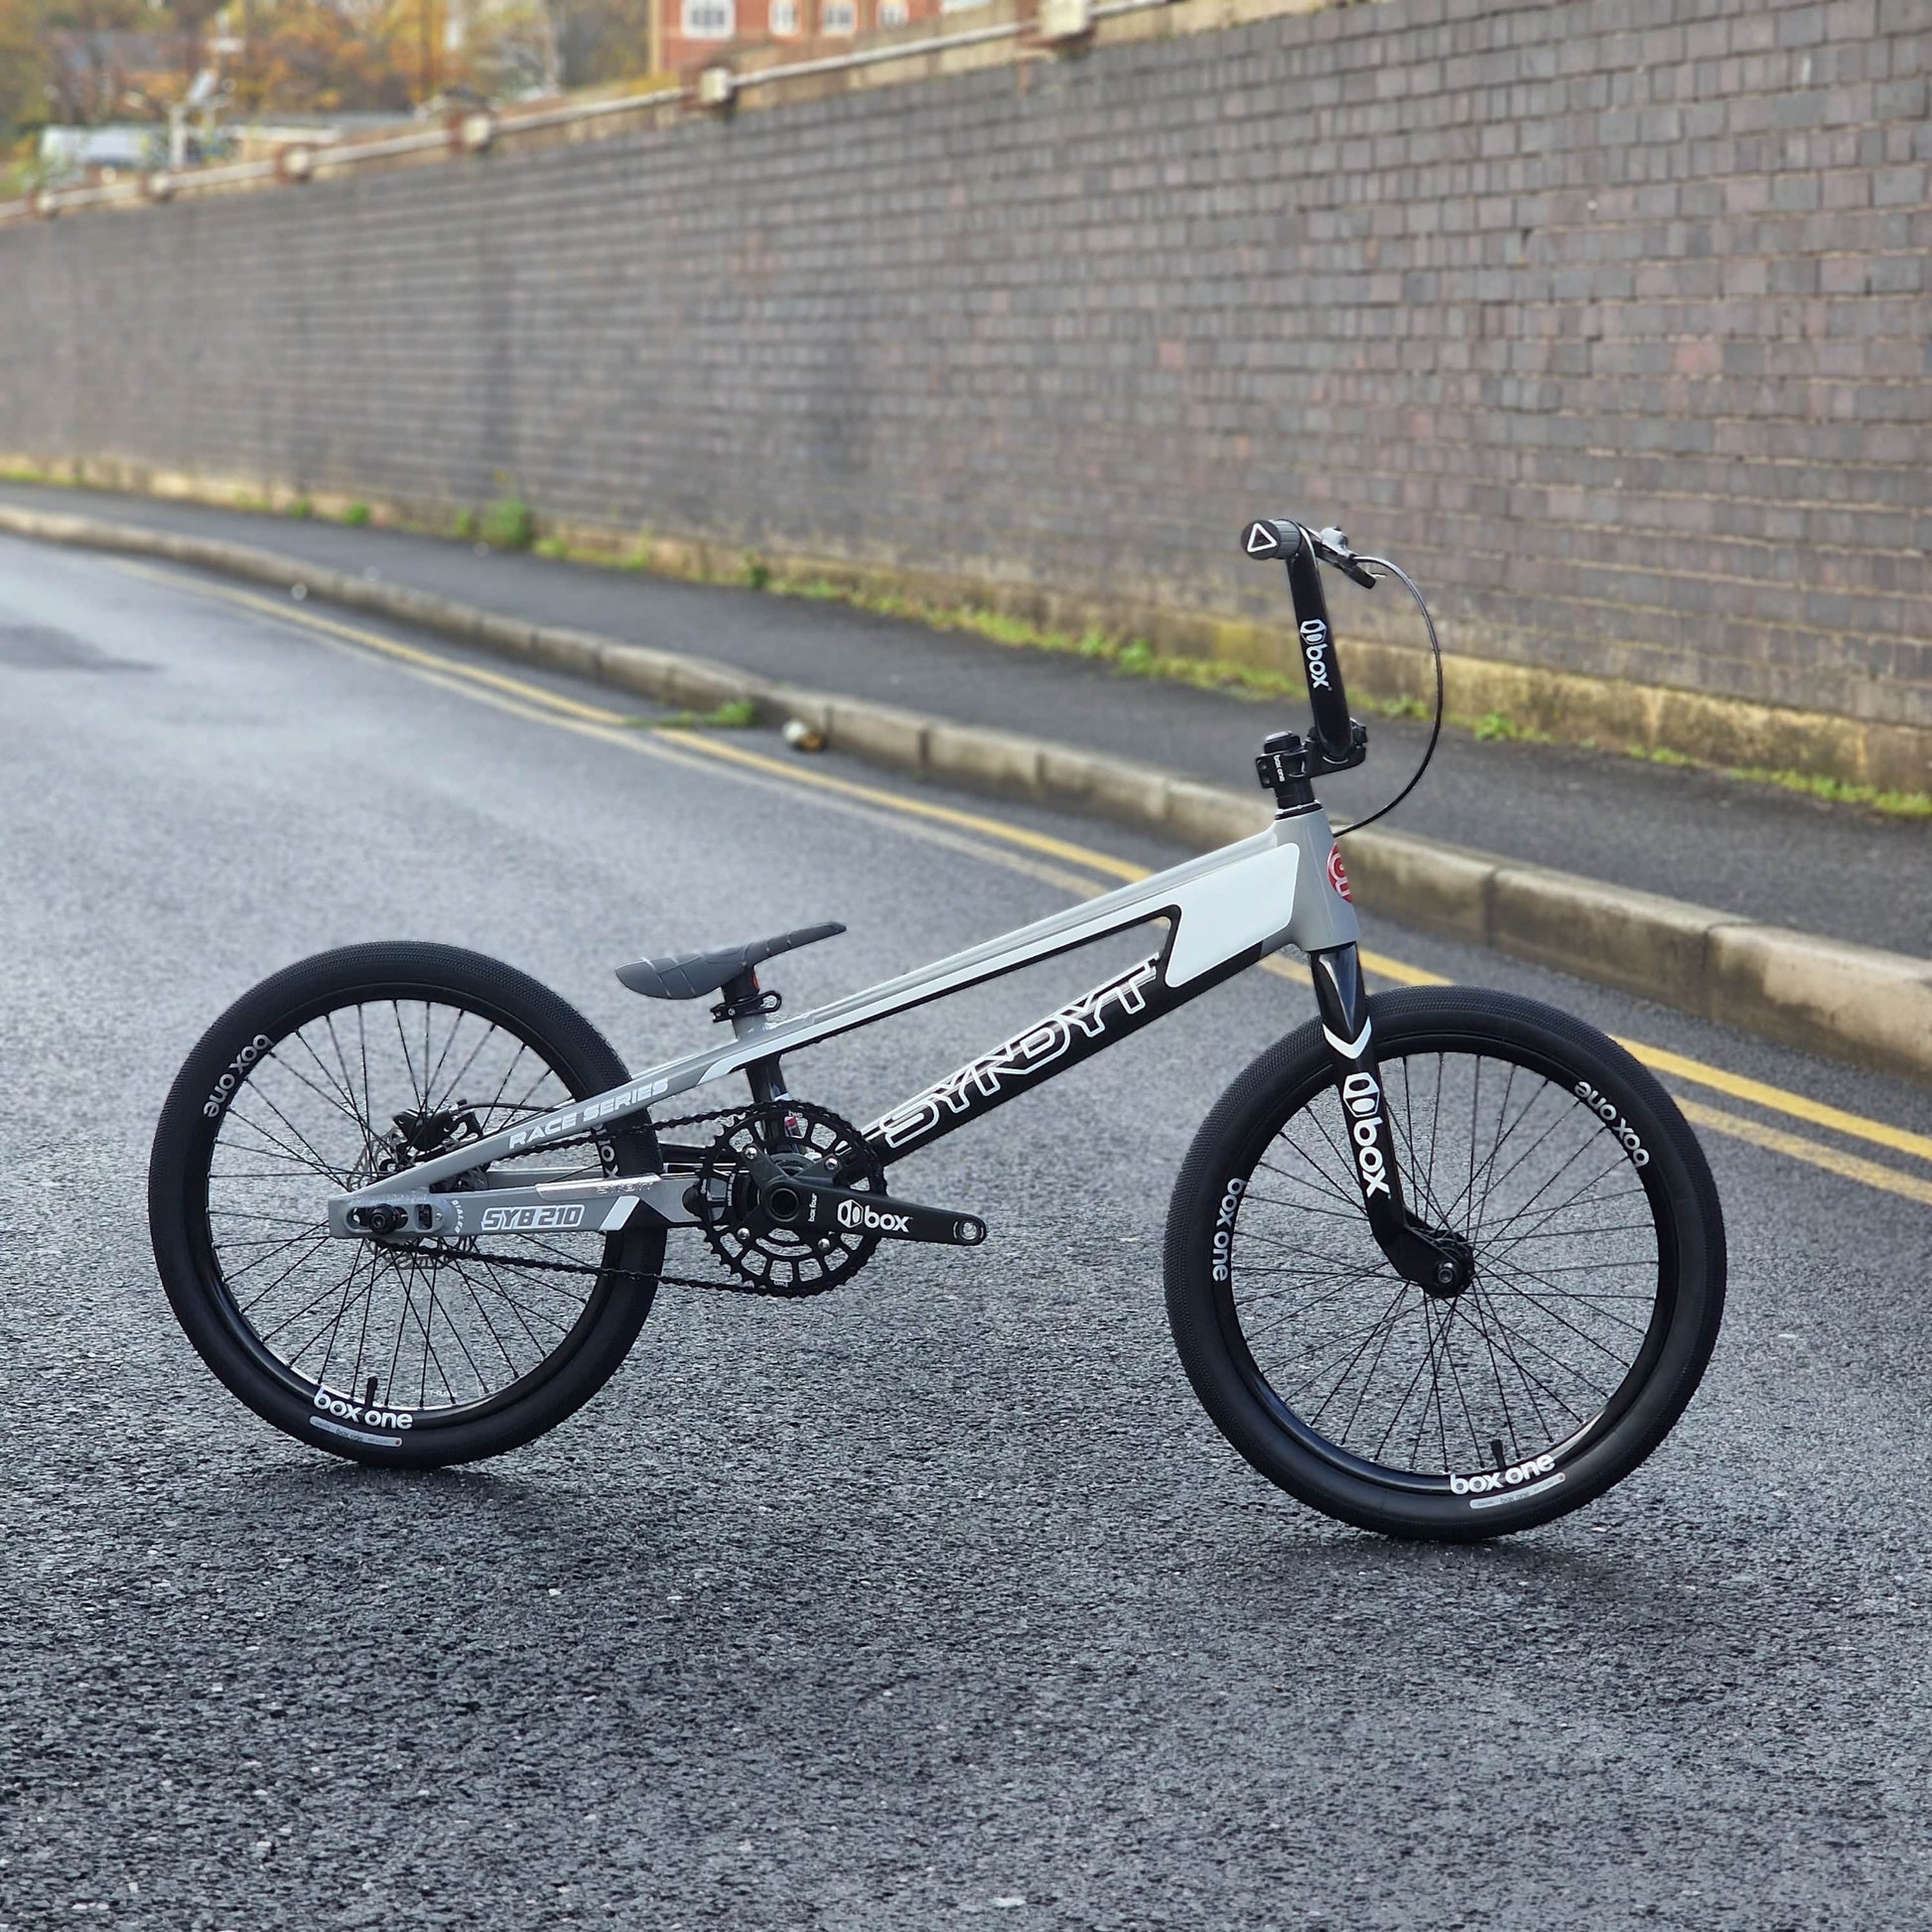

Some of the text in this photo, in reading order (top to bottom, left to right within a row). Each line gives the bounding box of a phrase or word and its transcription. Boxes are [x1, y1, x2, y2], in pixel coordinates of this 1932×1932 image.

[1307, 643, 1329, 688] box
[203, 1034, 276, 1118] box one
[508, 1077, 668, 1150] RACE SERIES
[1574, 1081, 1650, 1169] box one
[1353, 1116, 1391, 1199] box
[481, 1204, 585, 1231] SYB 210
[807, 1208, 816, 1222] box
[864, 1204, 909, 1233] box
[1212, 1177, 1247, 1282] box one
[314, 1385, 413, 1430] box one
[1449, 1472, 1504, 1495] box
[1505, 1454, 1556, 1484] one
